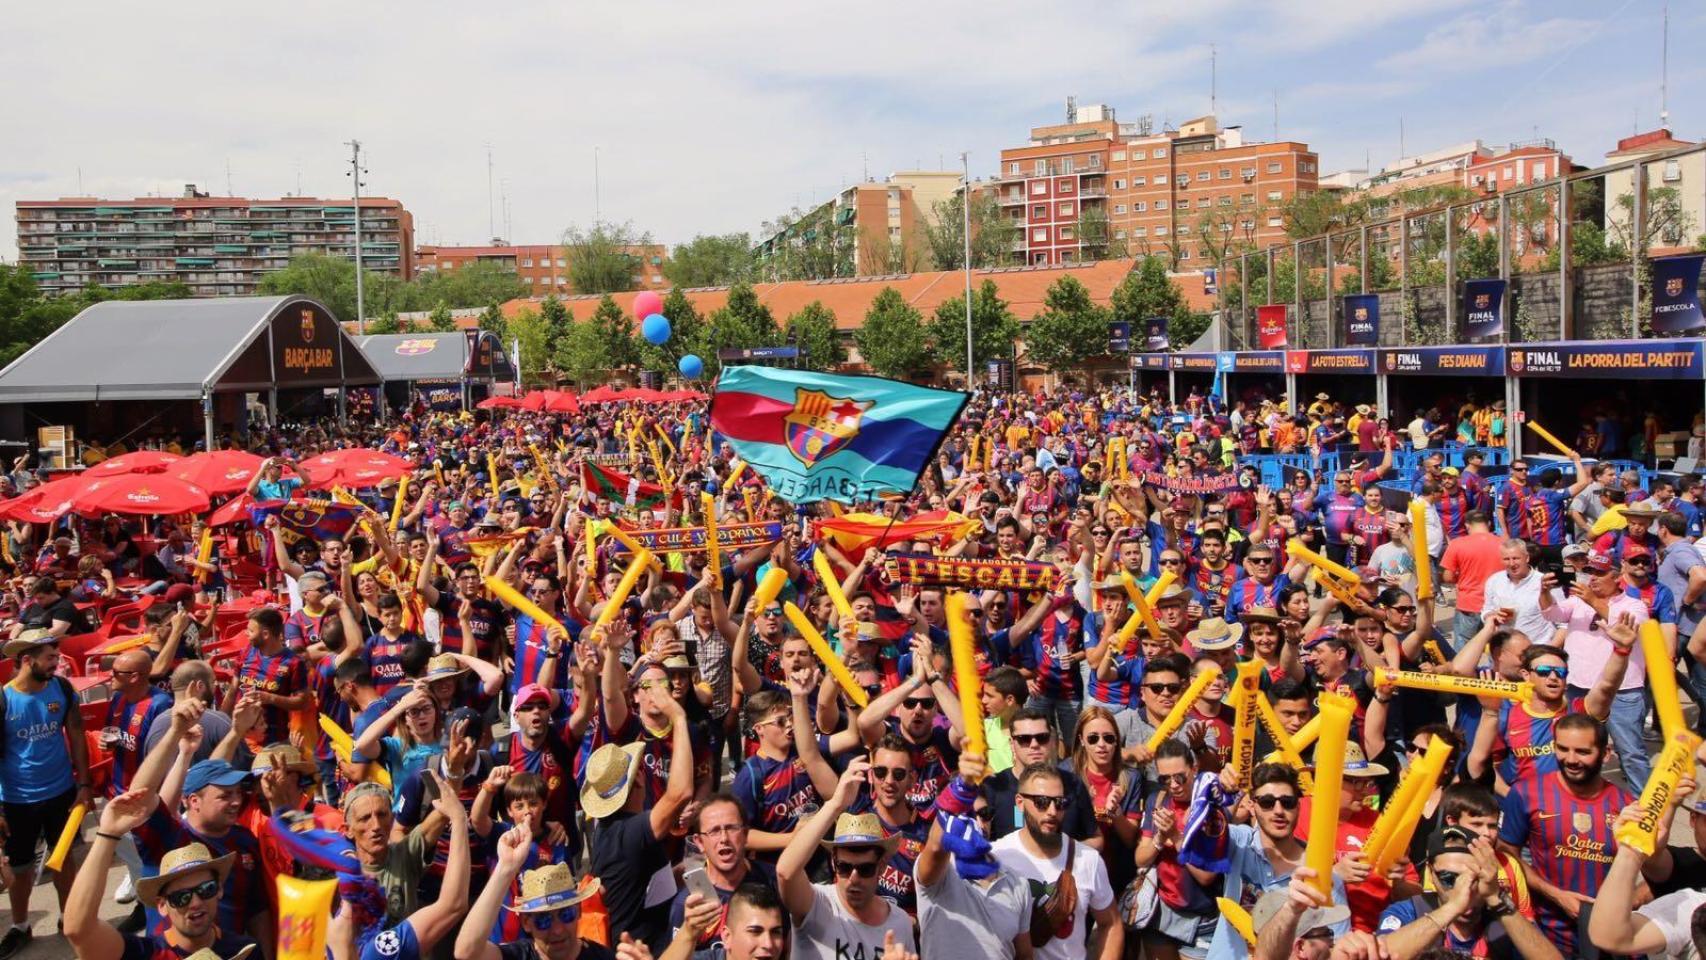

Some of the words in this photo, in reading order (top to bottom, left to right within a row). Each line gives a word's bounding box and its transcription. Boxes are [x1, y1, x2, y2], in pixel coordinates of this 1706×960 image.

[1469, 311, 1493, 320] FINAL
[285, 348, 316, 374] BARÇA
[316, 348, 333, 367] BAR
[1336, 355, 1370, 367] ESTRELLA
[1397, 353, 1421, 365] FINAL
[1439, 354, 1455, 368] FES
[1527, 352, 1561, 365] FINAL
[1569, 353, 1582, 367] LA
[1583, 353, 1623, 367] PORRA
[1623, 352, 1646, 367] DEL
[1647, 351, 1695, 366] PARTIT
[908, 559, 1054, 588] L'ESCALA
[469, 620, 490, 631] ATAR
[375, 663, 402, 675] QATA
[1403, 671, 1440, 682] FINAL
[1453, 678, 1519, 693] #COPAFCB
[1245, 694, 1257, 728] FINAL
[17, 721, 58, 740] QATAR
[774, 784, 815, 817] QATAR
[1638, 781, 1671, 833] #COPAFCB
[1566, 834, 1606, 851] Qatar
[1555, 845, 1614, 864] Foundation
[881, 865, 912, 888] TAR
